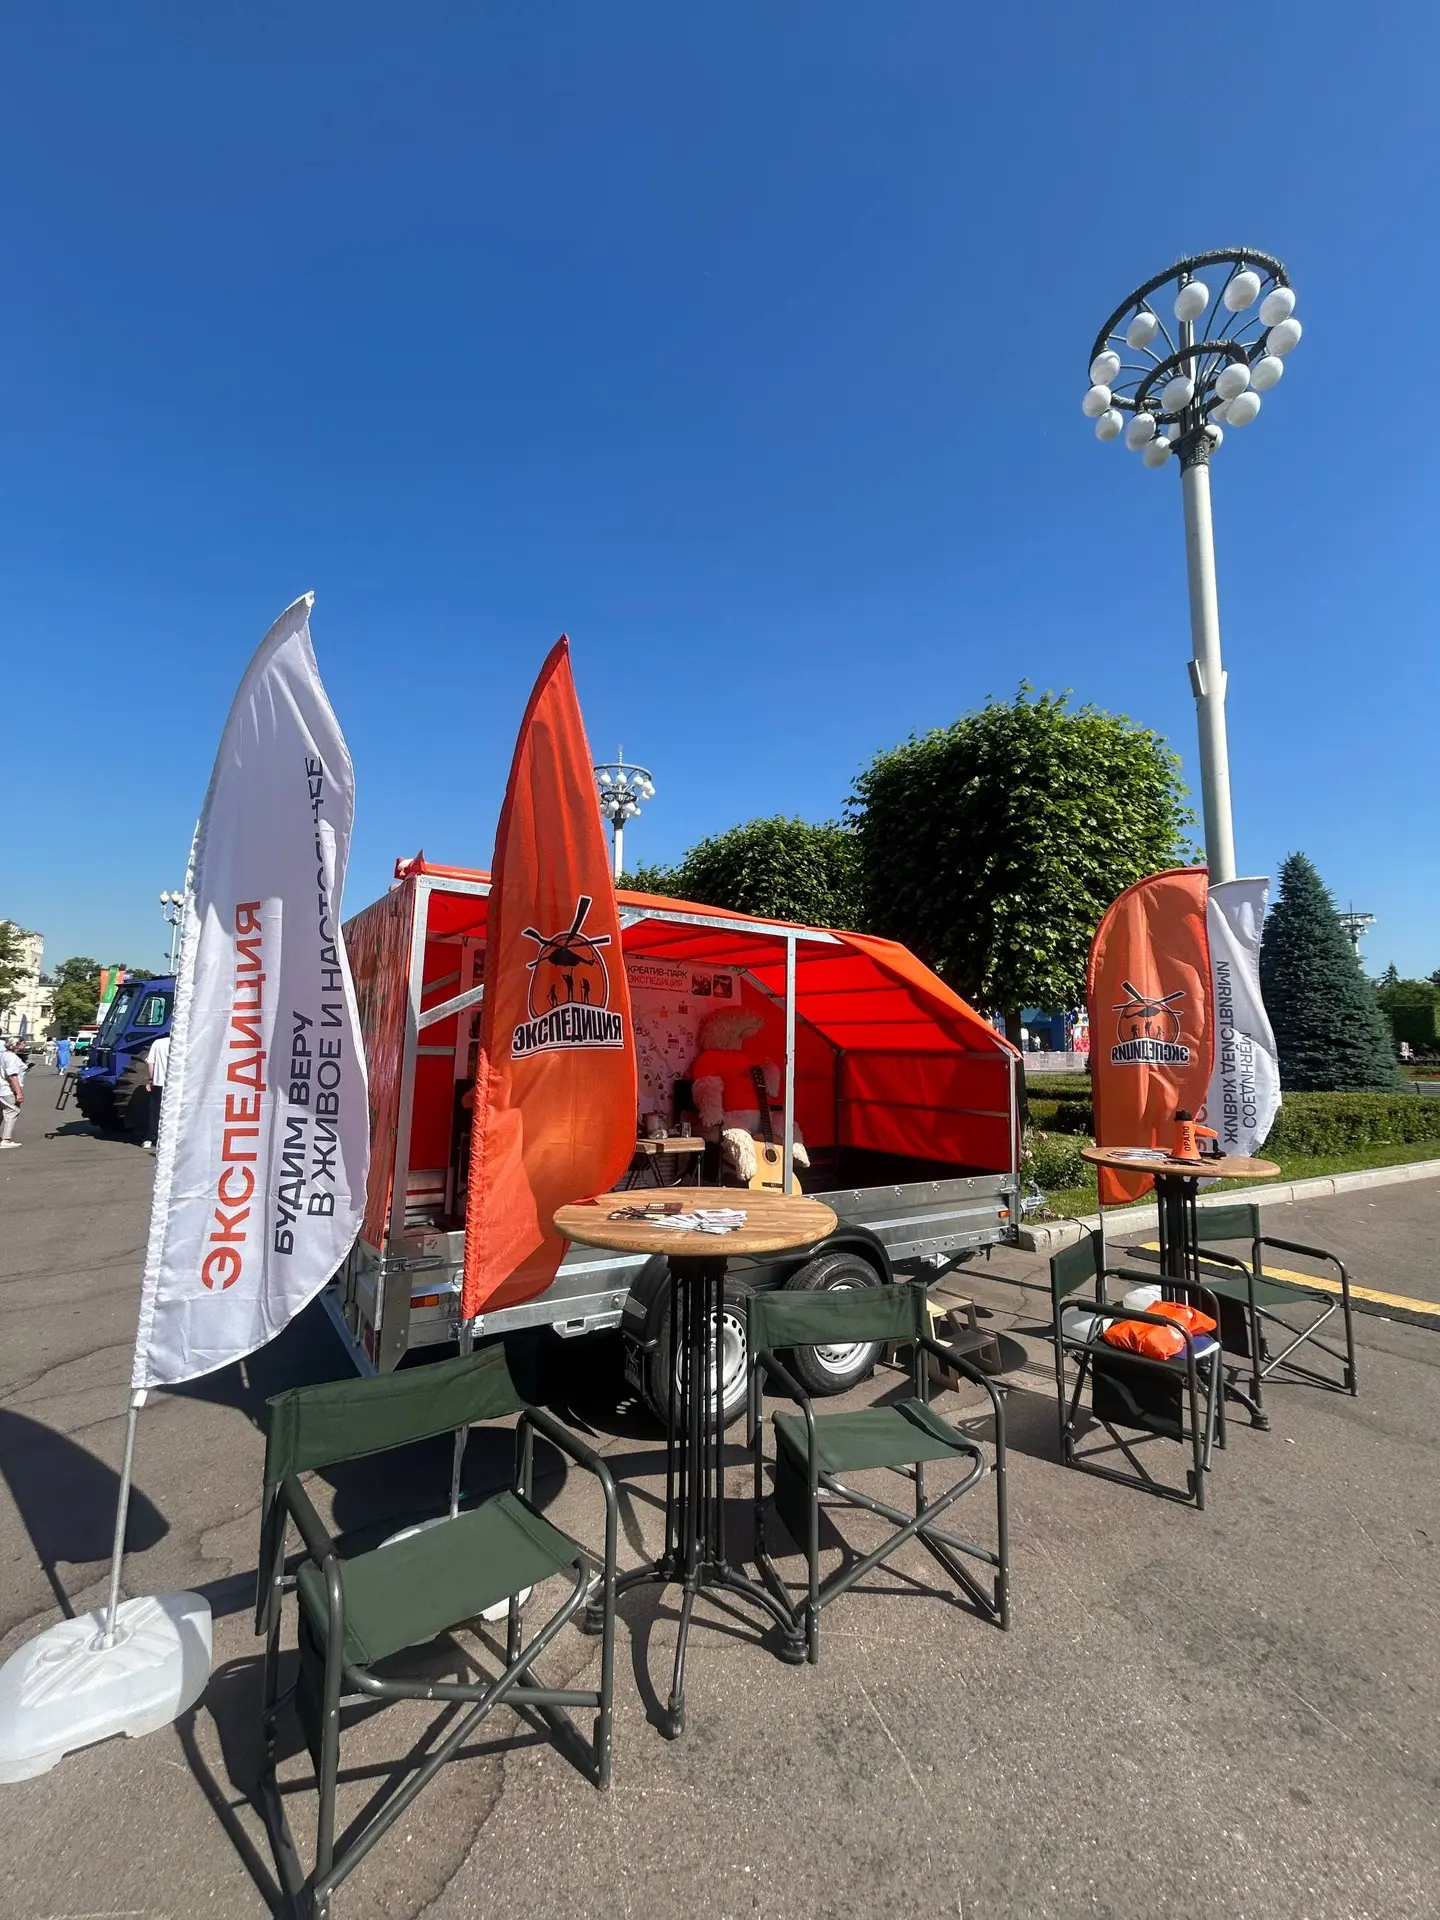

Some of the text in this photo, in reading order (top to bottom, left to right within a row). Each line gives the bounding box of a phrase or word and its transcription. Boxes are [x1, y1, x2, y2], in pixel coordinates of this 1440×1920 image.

[627, 965, 688, 978] КРЕАТИВ-ПАРК
[320, 1003, 343, 1027] И
[513, 1006, 622, 1051] ЭКСПЕДИЦИЯ
[201, 901, 267, 1290] ЭКСПЕДИЦИЯ
[311, 1038, 342, 1182] ЖИВОЕ
[274, 1010, 313, 1255] БУДИМ ВЕРУ
[1182, 1126, 1191, 1151] ОРАЛО
[307, 1191, 334, 1216] В
